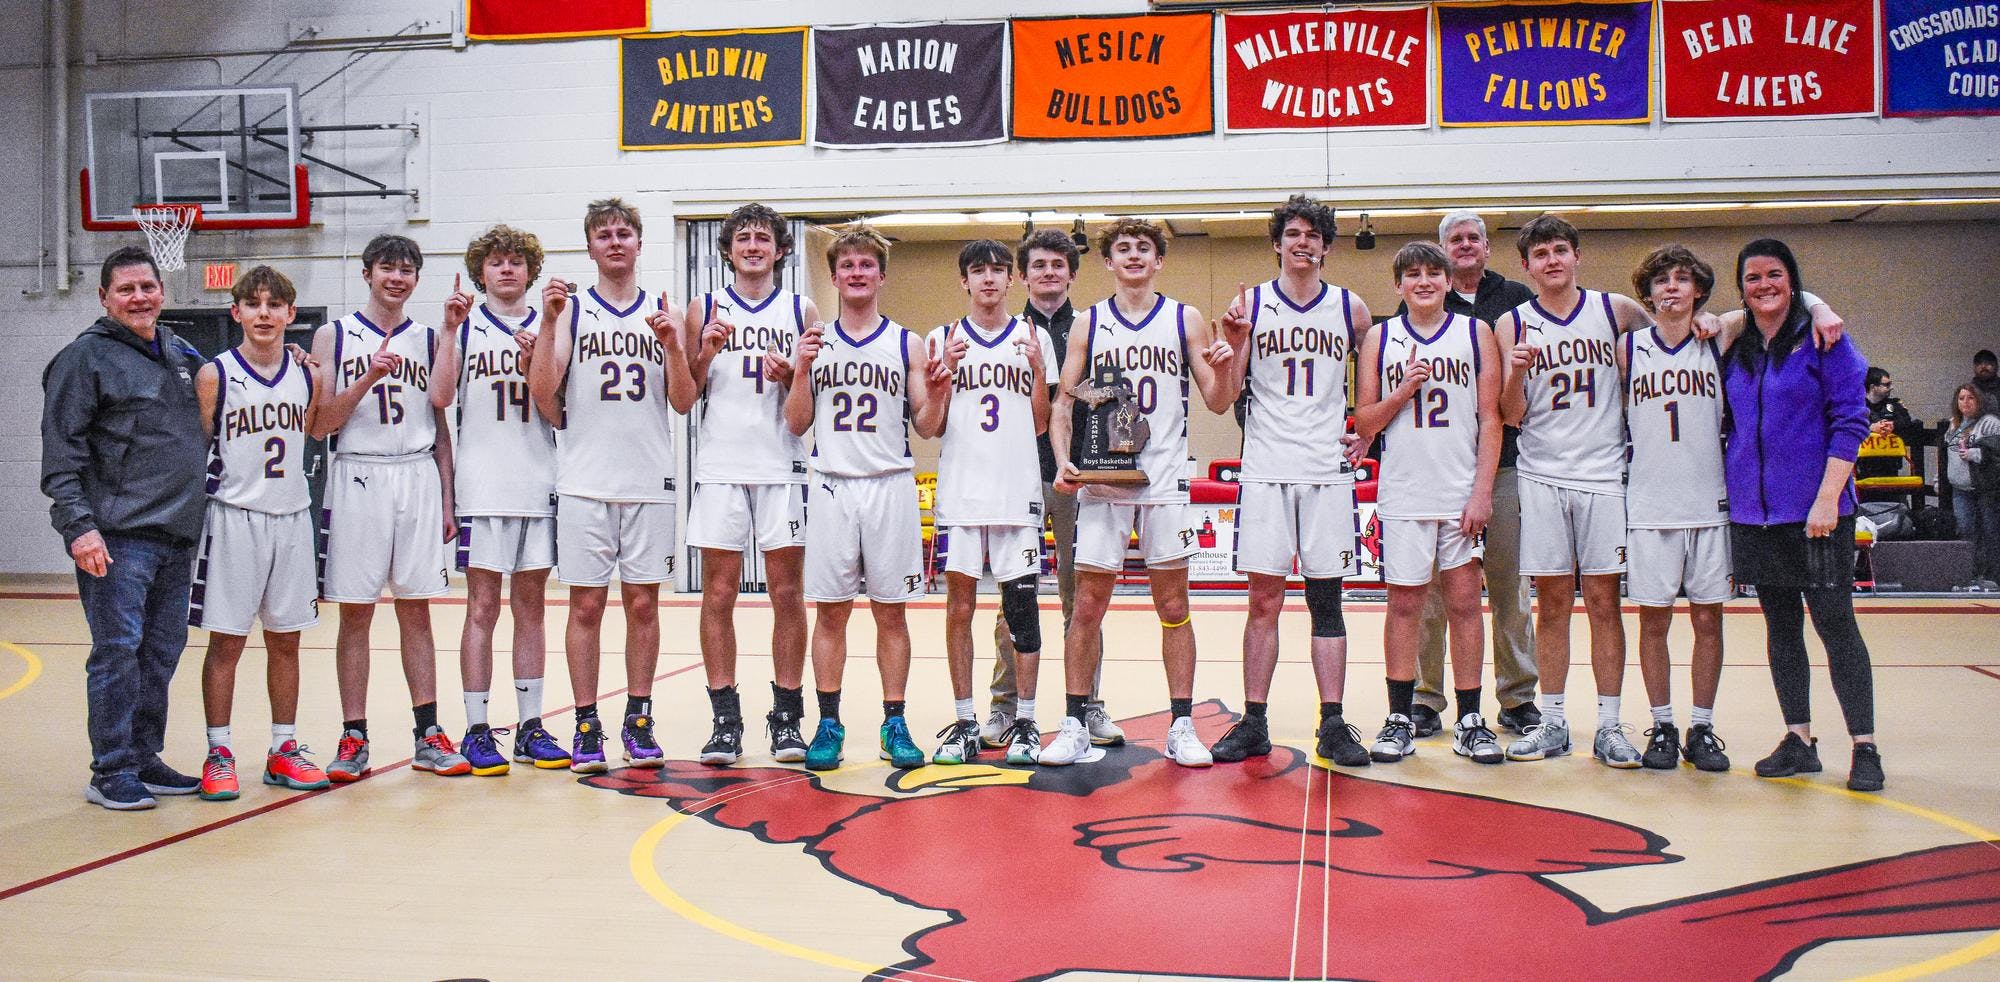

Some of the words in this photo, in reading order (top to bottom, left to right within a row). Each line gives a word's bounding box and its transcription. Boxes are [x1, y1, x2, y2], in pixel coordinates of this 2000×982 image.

[1233, 20, 1420, 71] WALKERVILLE
[1464, 16, 1627, 63] PENTWATER
[1681, 13, 1754, 61] BEAR
[1784, 12, 1858, 56] LAKE
[1889, 4, 1999, 52] CROSSROADS
[657, 46, 768, 86] BALDWIN
[856, 38, 959, 78] MARION
[1054, 30, 1165, 70] MESICK
[1943, 39, 2000, 68] ACAD
[1046, 85, 1182, 127] BULLDOGS
[1261, 76, 1394, 119] WILDCATS
[1483, 71, 1608, 112] FALCONS
[1716, 70, 1823, 107] LAKERS
[650, 94, 774, 134] PANTHERS
[853, 94, 963, 132] EAGLES
[206, 263, 235, 289] EXIT
[579, 330, 665, 366] FALCONS
[717, 325, 794, 358] ALCONS
[1256, 326, 1344, 361] FALCONS
[342, 353, 428, 392] FAONS
[466, 349, 524, 383] FALCO
[600, 360, 646, 402] 23
[742, 355, 764, 394] 4
[813, 360, 901, 398] FALCONS
[1282, 357, 1315, 397] 11
[1386, 356, 1470, 393] FAONS
[372, 383, 404, 425] 15
[491, 380, 530, 423] 14
[1121, 375, 1158, 415] 0
[1410, 387, 1450, 428] 12
[1550, 367, 1596, 411] 24
[1632, 368, 1716, 407] FALCONS
[225, 401, 307, 442] FALCON
[832, 391, 878, 433] 22
[980, 393, 1000, 433] 3
[1663, 400, 1681, 443] 1
[1090, 414, 1099, 455] CHAMPION
[1861, 435, 1900, 449] MCE
[263, 436, 286, 479] 2
[1082, 458, 1099, 466] Boys
